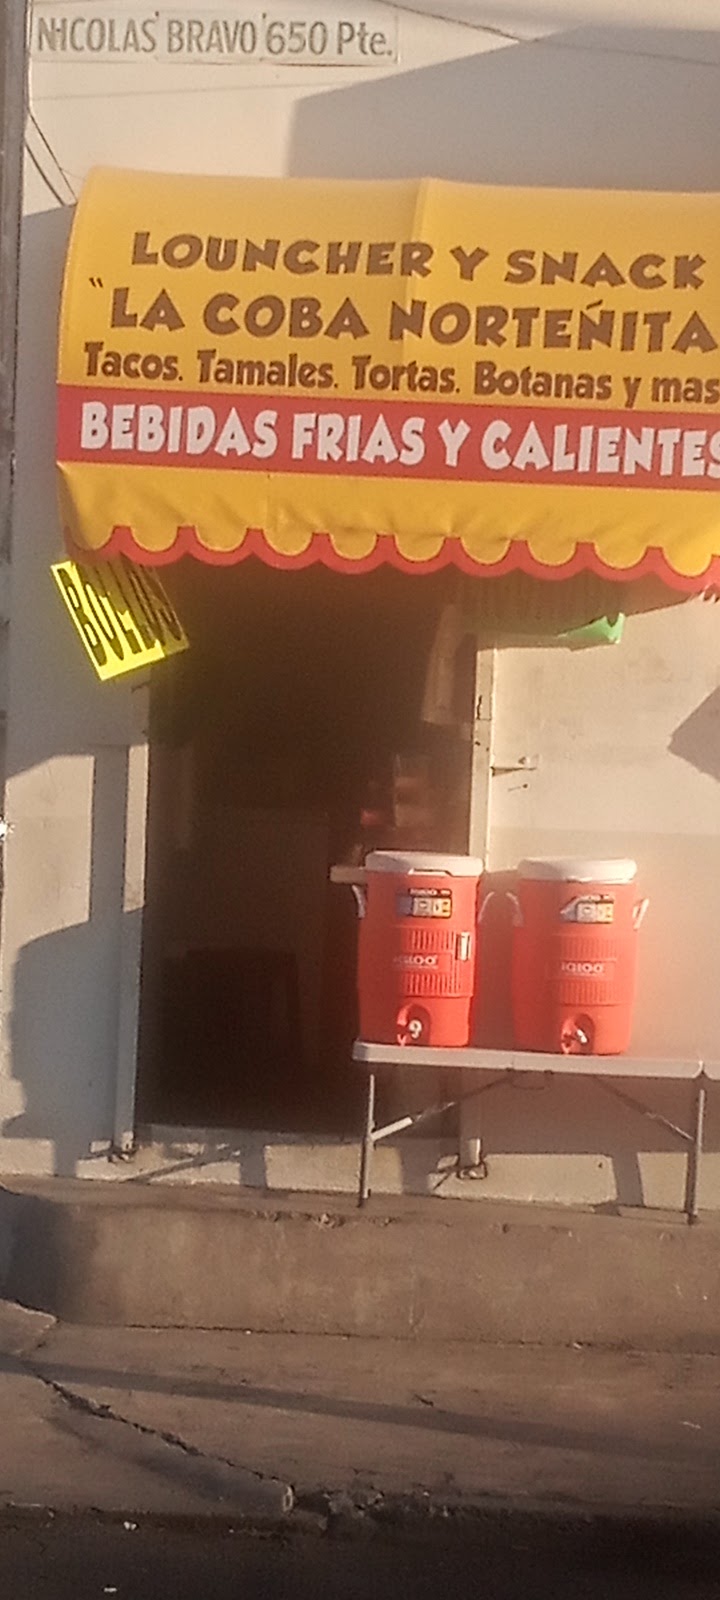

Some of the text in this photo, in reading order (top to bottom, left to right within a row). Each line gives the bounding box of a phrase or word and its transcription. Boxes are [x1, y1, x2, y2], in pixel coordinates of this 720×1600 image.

[167, 19, 256, 54] BRAVO
[266, 21, 327, 56] 650
[337, 21, 393, 56] Pte.
[131, 231, 706, 290] LOUNCHER Y SNACK
[203, 292, 370, 340] COBA
[84, 341, 720, 408] Tacos. Tamales. Tortas. Botanas y mas
[80, 401, 278, 458] BEBIDAS
[291, 412, 425, 466] FRIAS
[438, 418, 471, 467] Y
